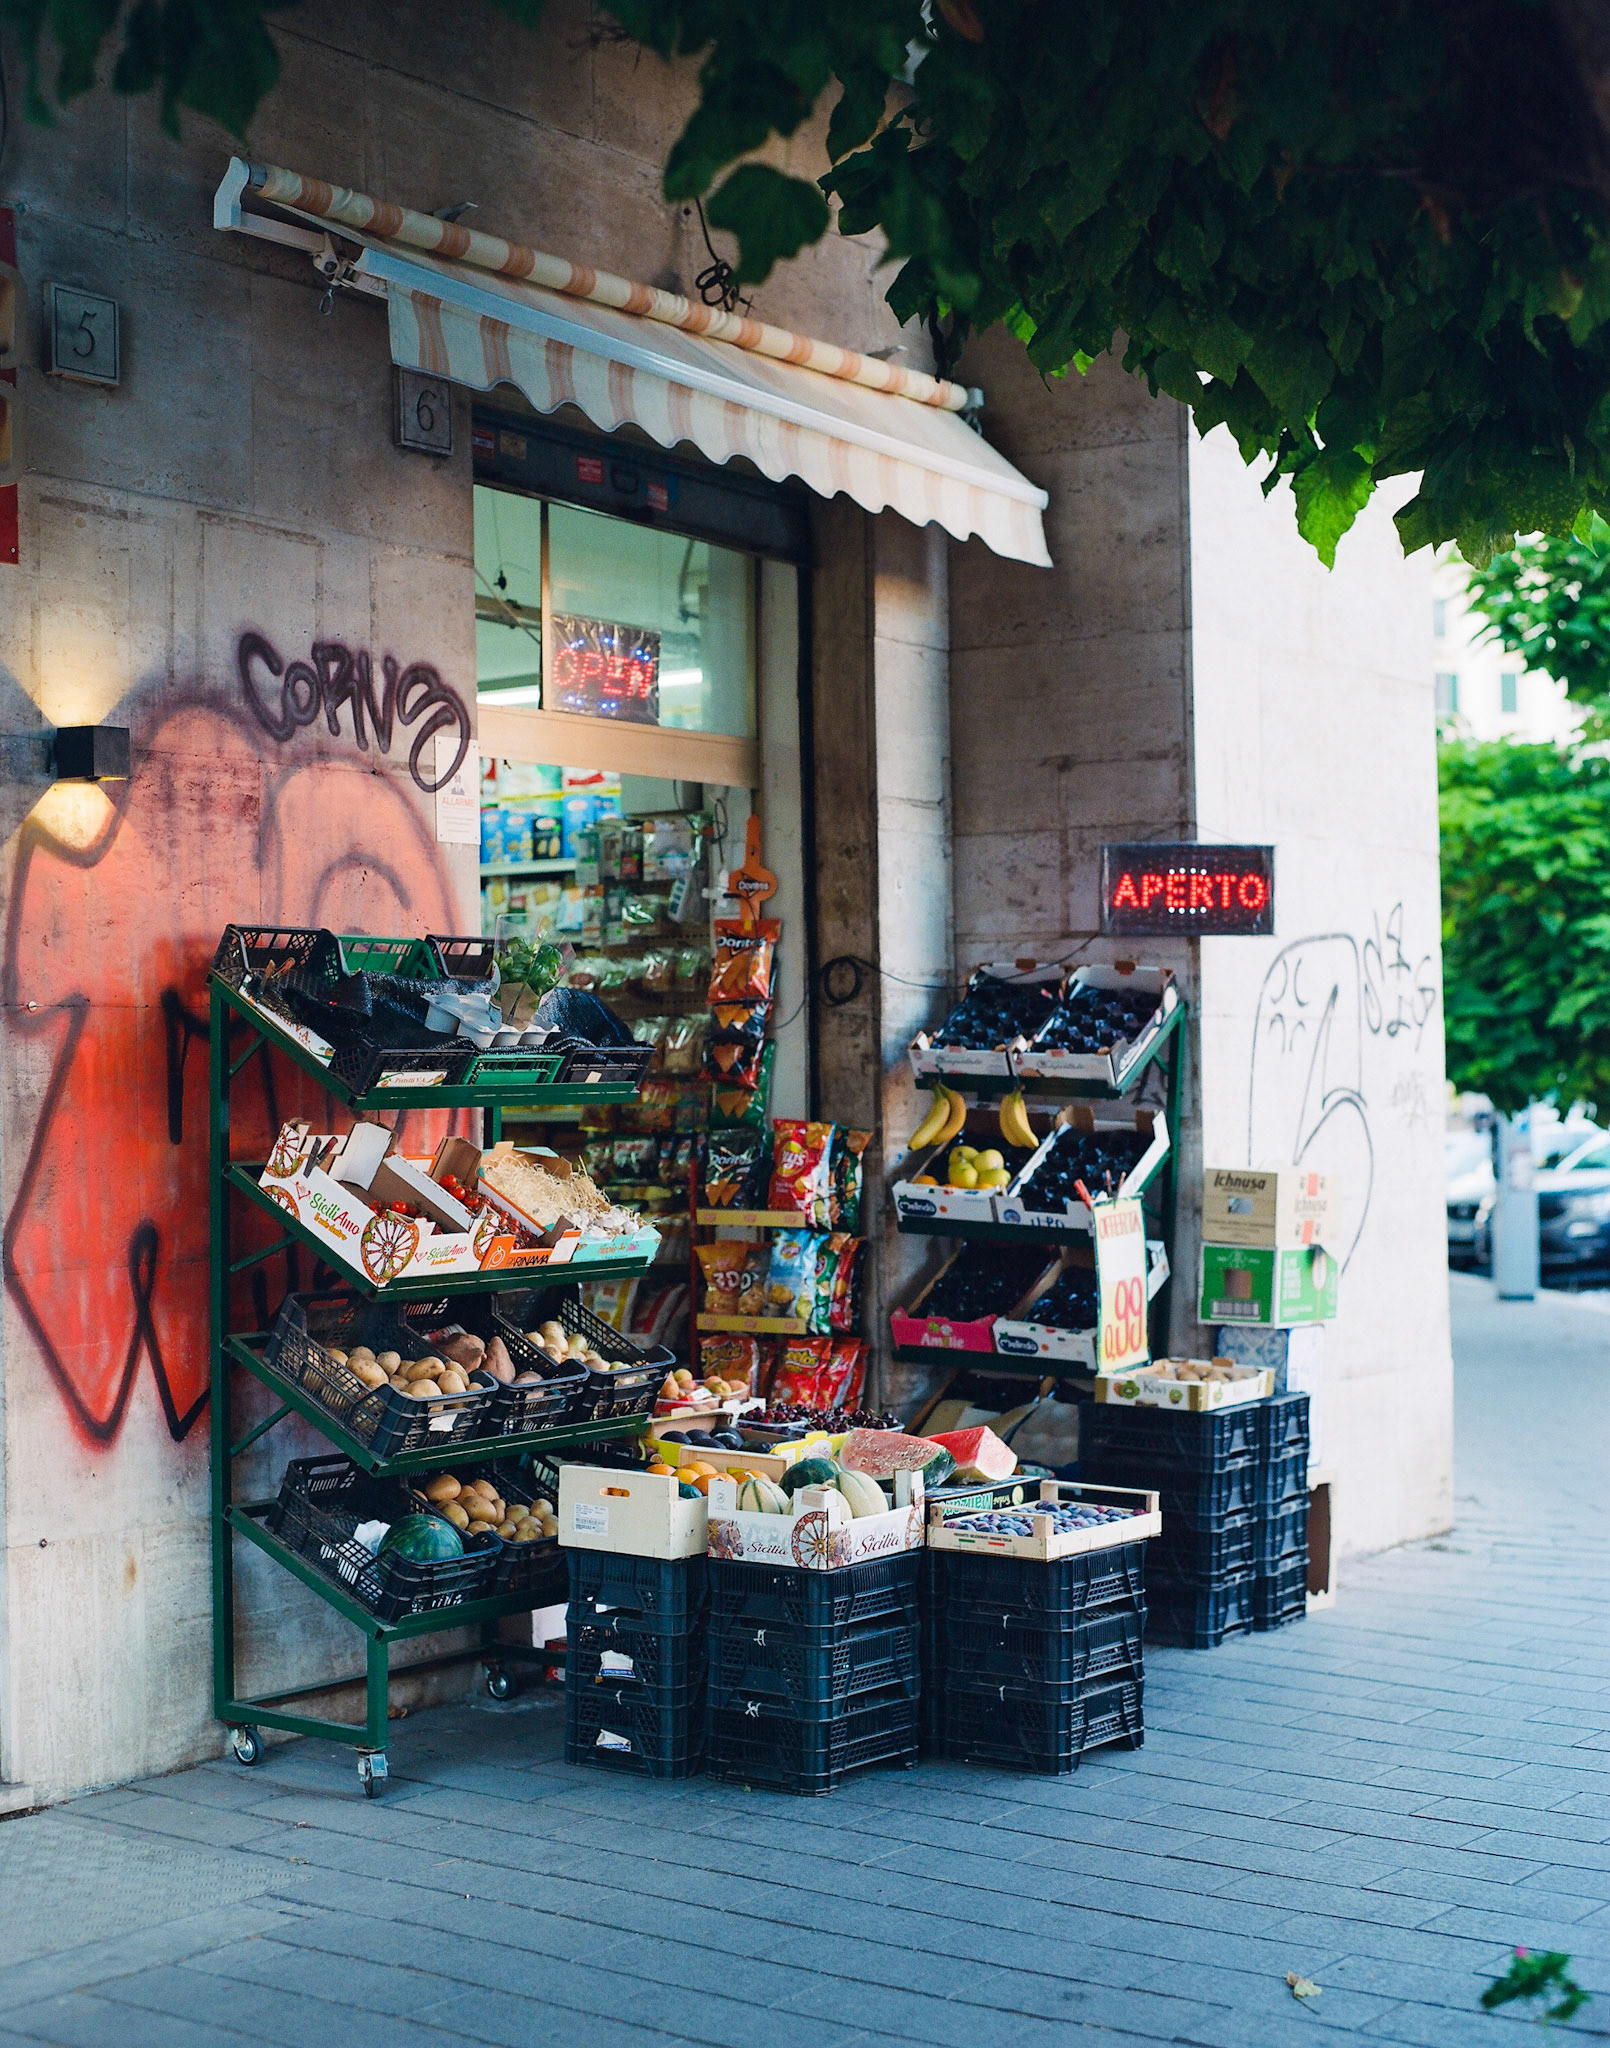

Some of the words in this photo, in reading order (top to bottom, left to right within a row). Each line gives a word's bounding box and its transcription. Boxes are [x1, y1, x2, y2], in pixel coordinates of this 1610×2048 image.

[73, 310, 97, 358] 5
[416, 389, 438, 432] 6
[553, 648, 655, 699] OPEN
[1112, 872, 1266, 909] APERTO
[309, 1192, 361, 1237] SiciliAmo
[1099, 1211, 1142, 1240] OFFERTA
[426, 1243, 467, 1262] SiciliAmo
[1105, 1276, 1143, 1362] 0,99
[746, 1541, 789, 1556] Sicilia
[855, 1532, 901, 1558] Sicilia
